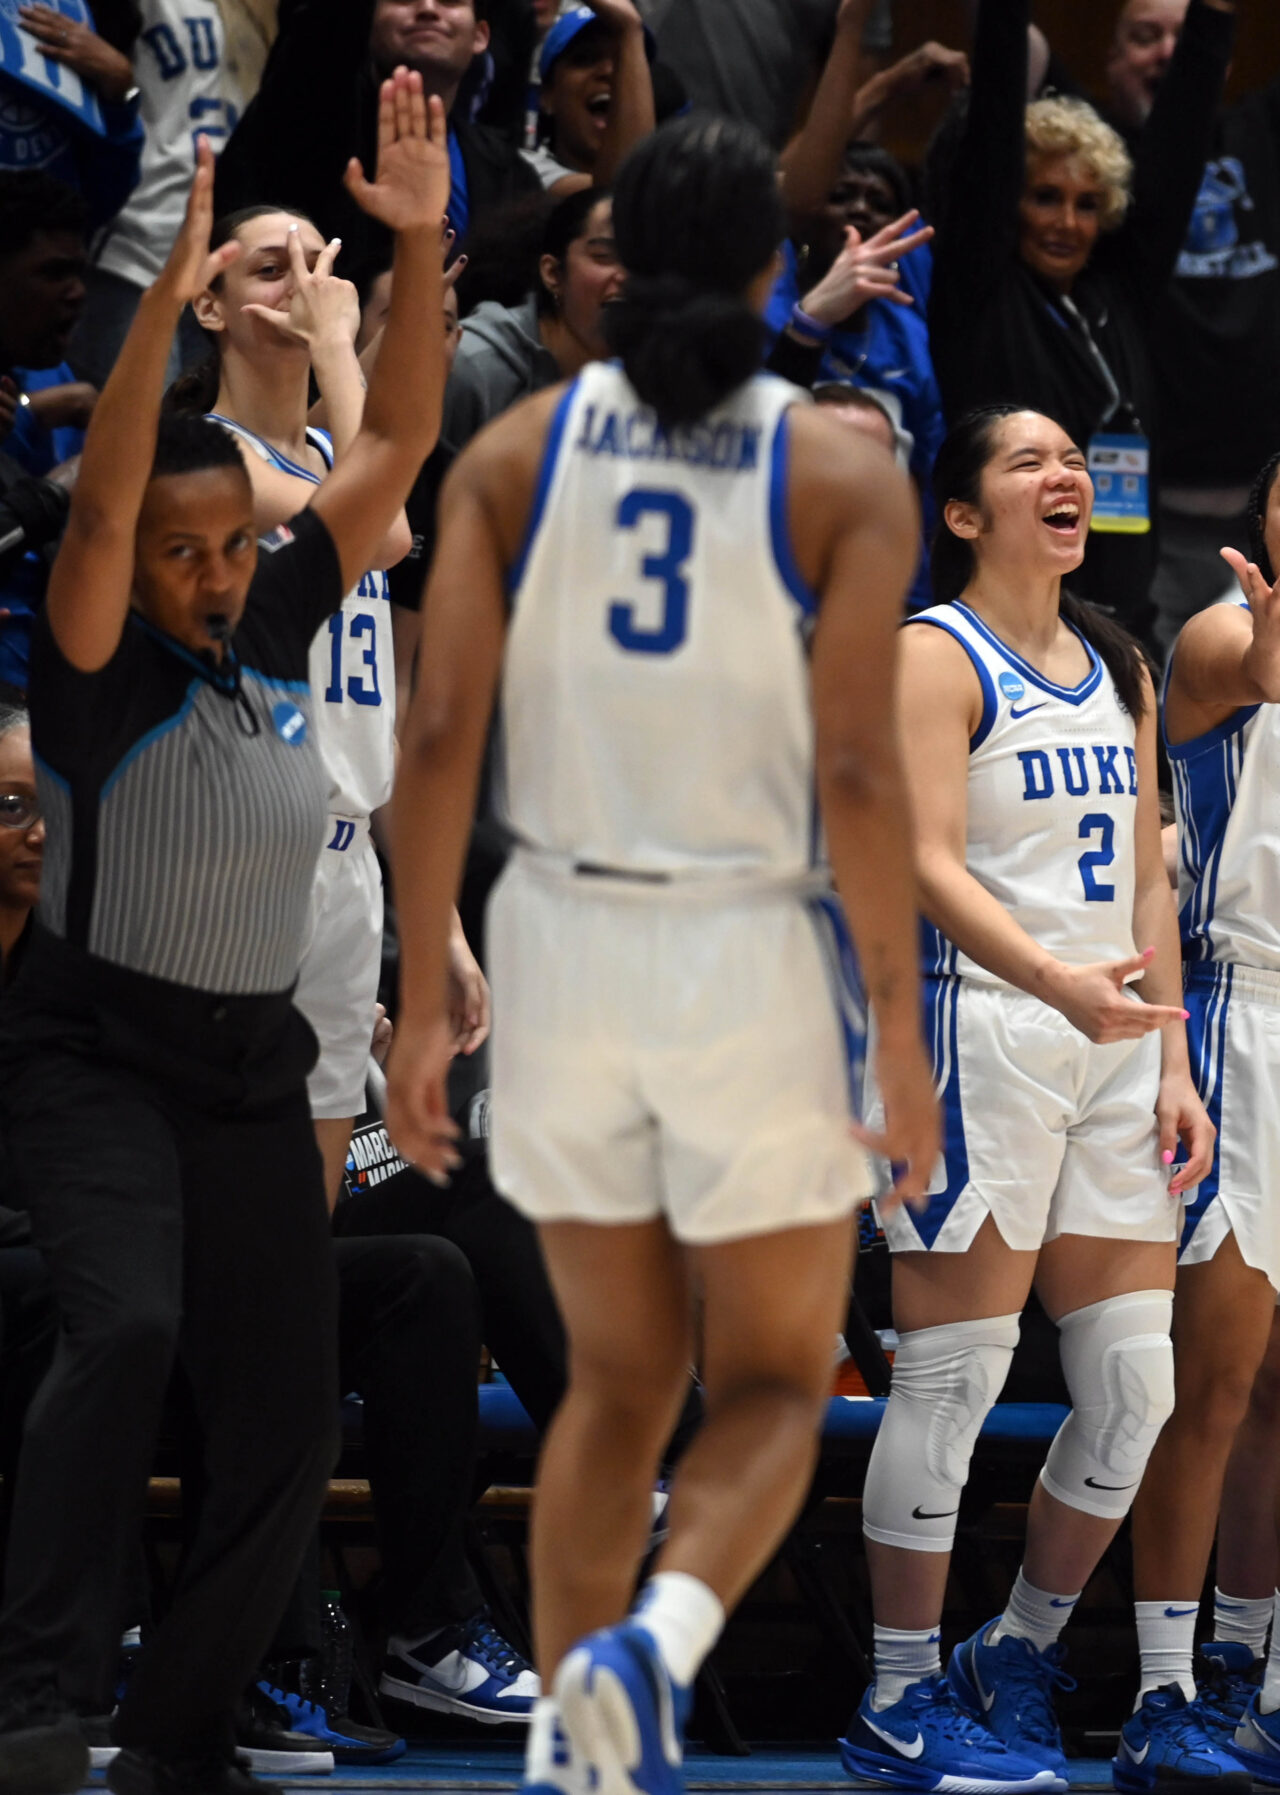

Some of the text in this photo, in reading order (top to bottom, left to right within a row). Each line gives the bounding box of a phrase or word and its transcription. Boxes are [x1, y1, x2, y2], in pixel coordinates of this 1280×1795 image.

[606, 488, 695, 653] 3
[325, 610, 382, 706] 13
[1078, 813, 1115, 902] 2
